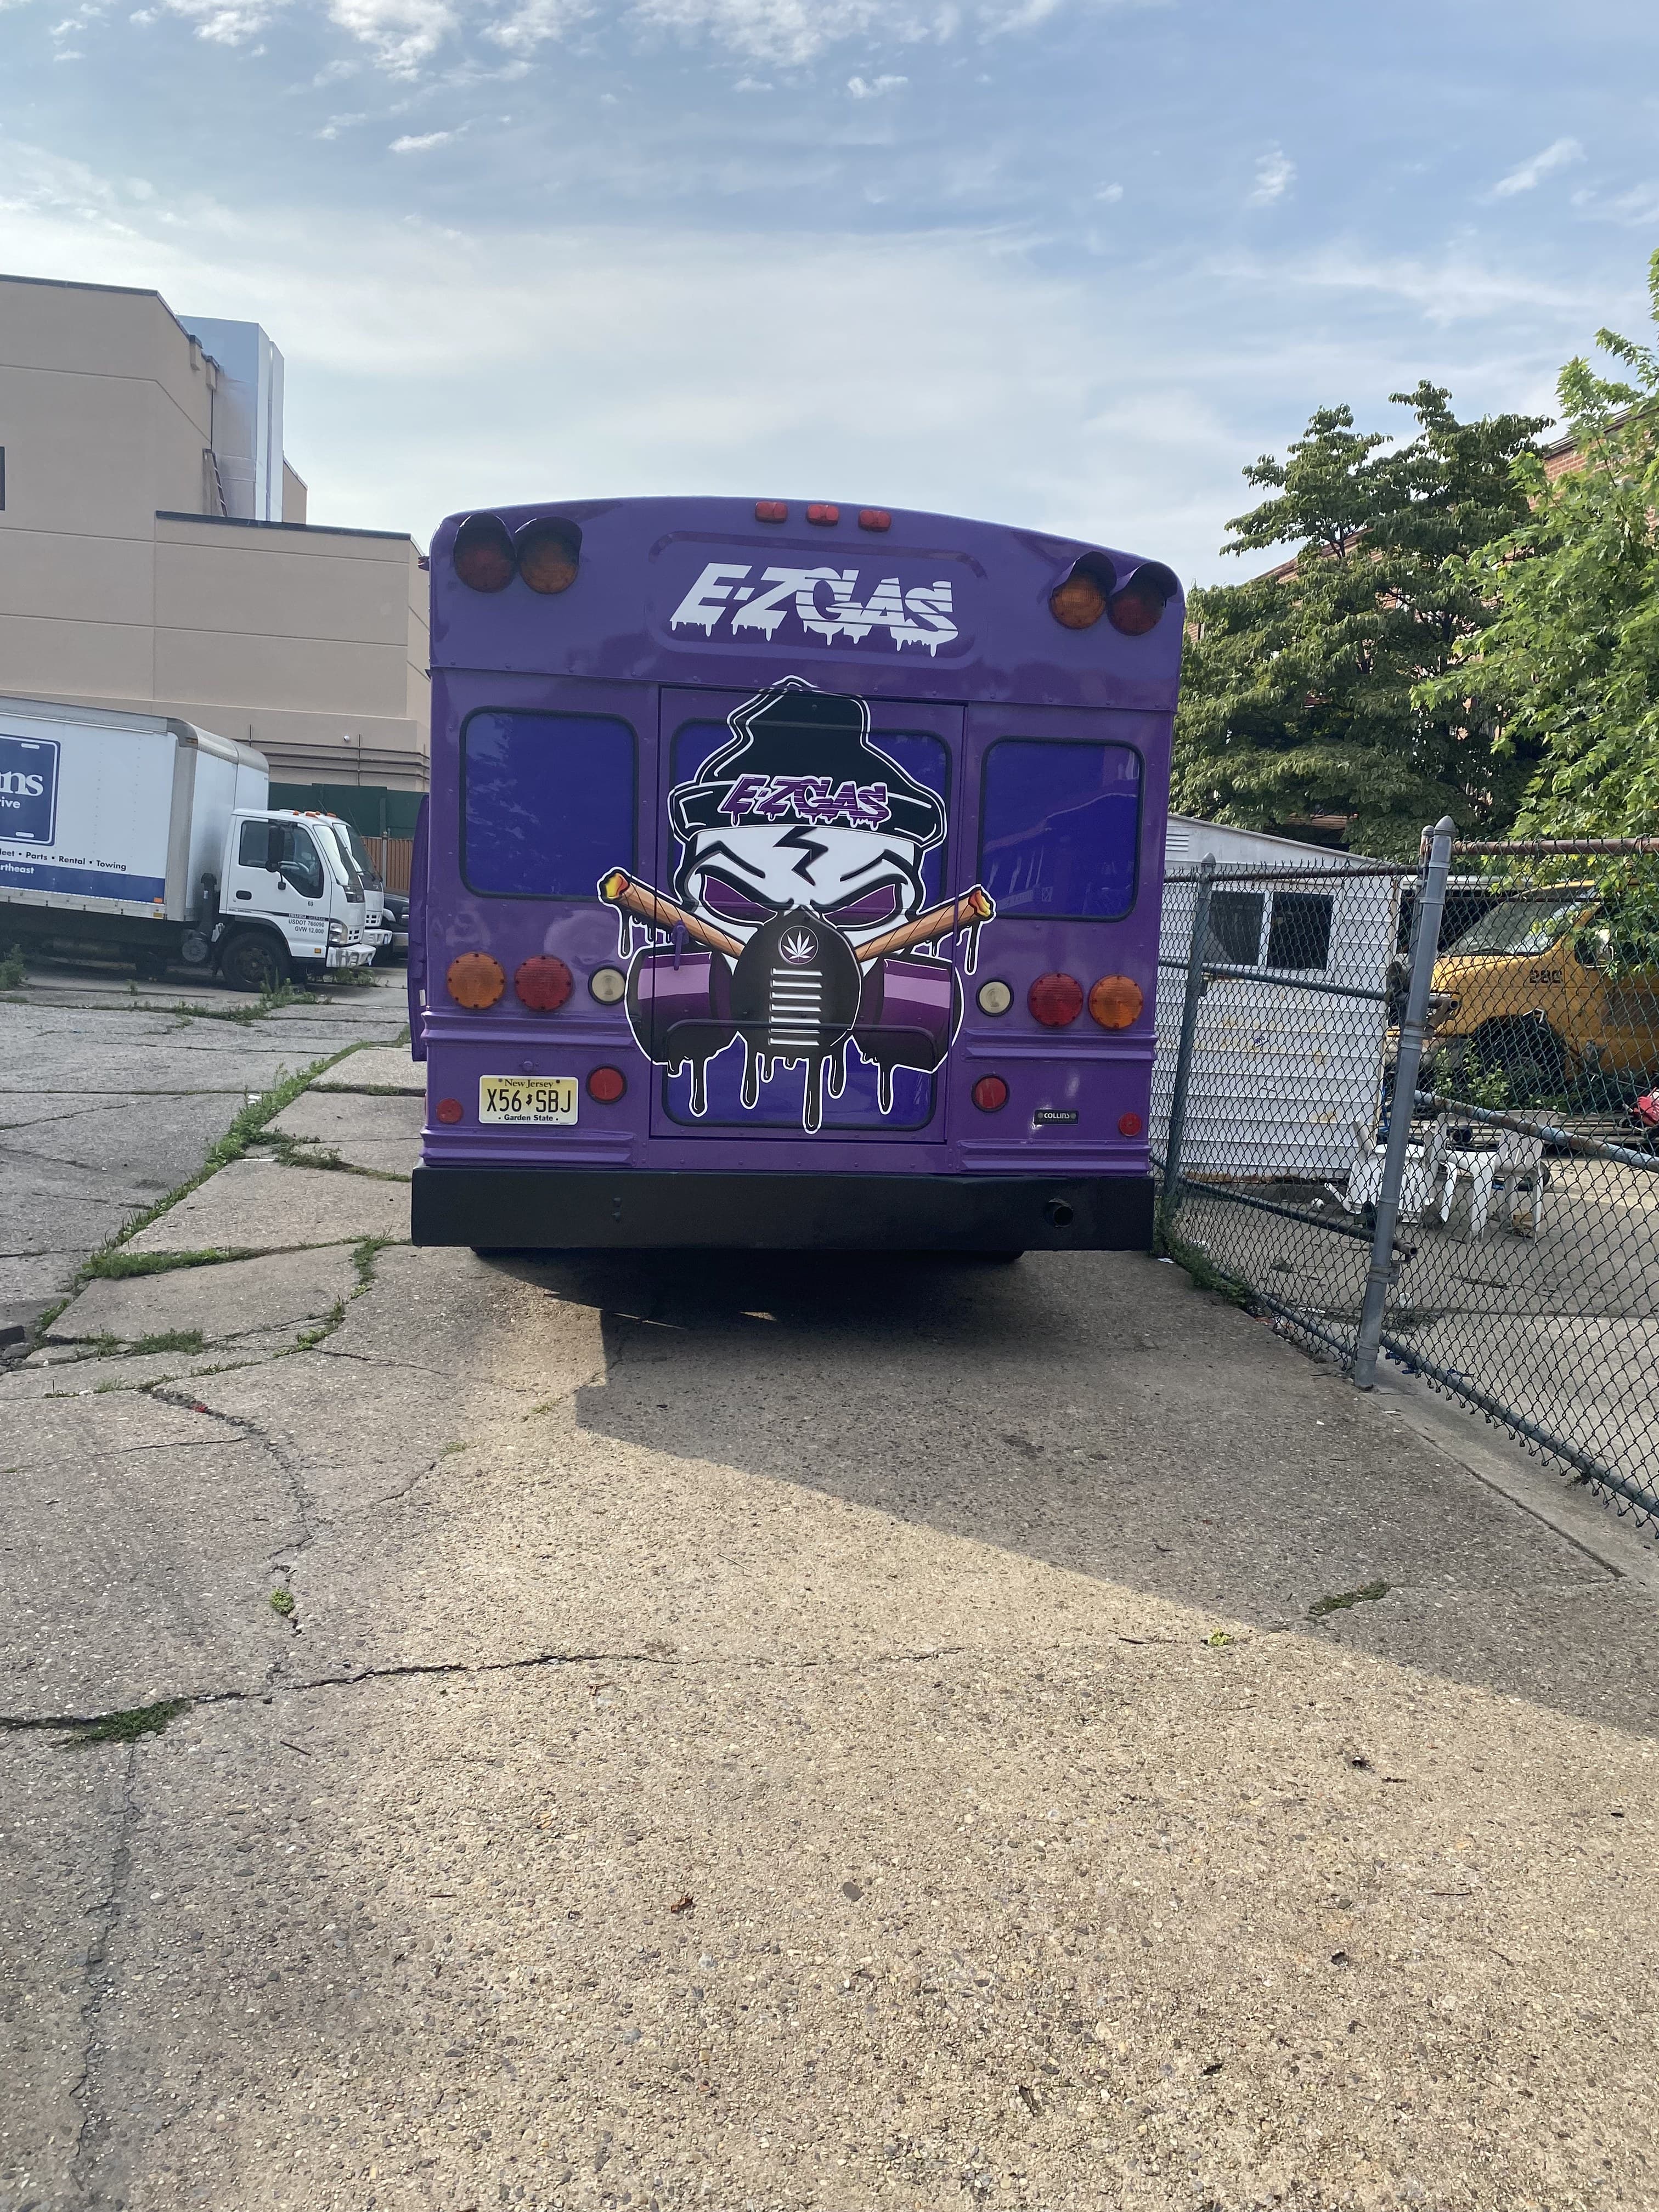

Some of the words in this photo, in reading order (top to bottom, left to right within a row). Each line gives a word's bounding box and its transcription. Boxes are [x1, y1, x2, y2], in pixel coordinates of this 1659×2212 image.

[0, 771, 43, 796] ns
[0, 863, 35, 874] rtheast
[26, 852, 48, 861] Parts
[59, 856, 86, 865] Rental
[97, 860, 127, 871] Towing
[504, 1079, 525, 1087] New
[526, 1080, 554, 1089] Jersey
[487, 1088, 522, 1112] X56
[535, 1090, 571, 1113] SBJ
